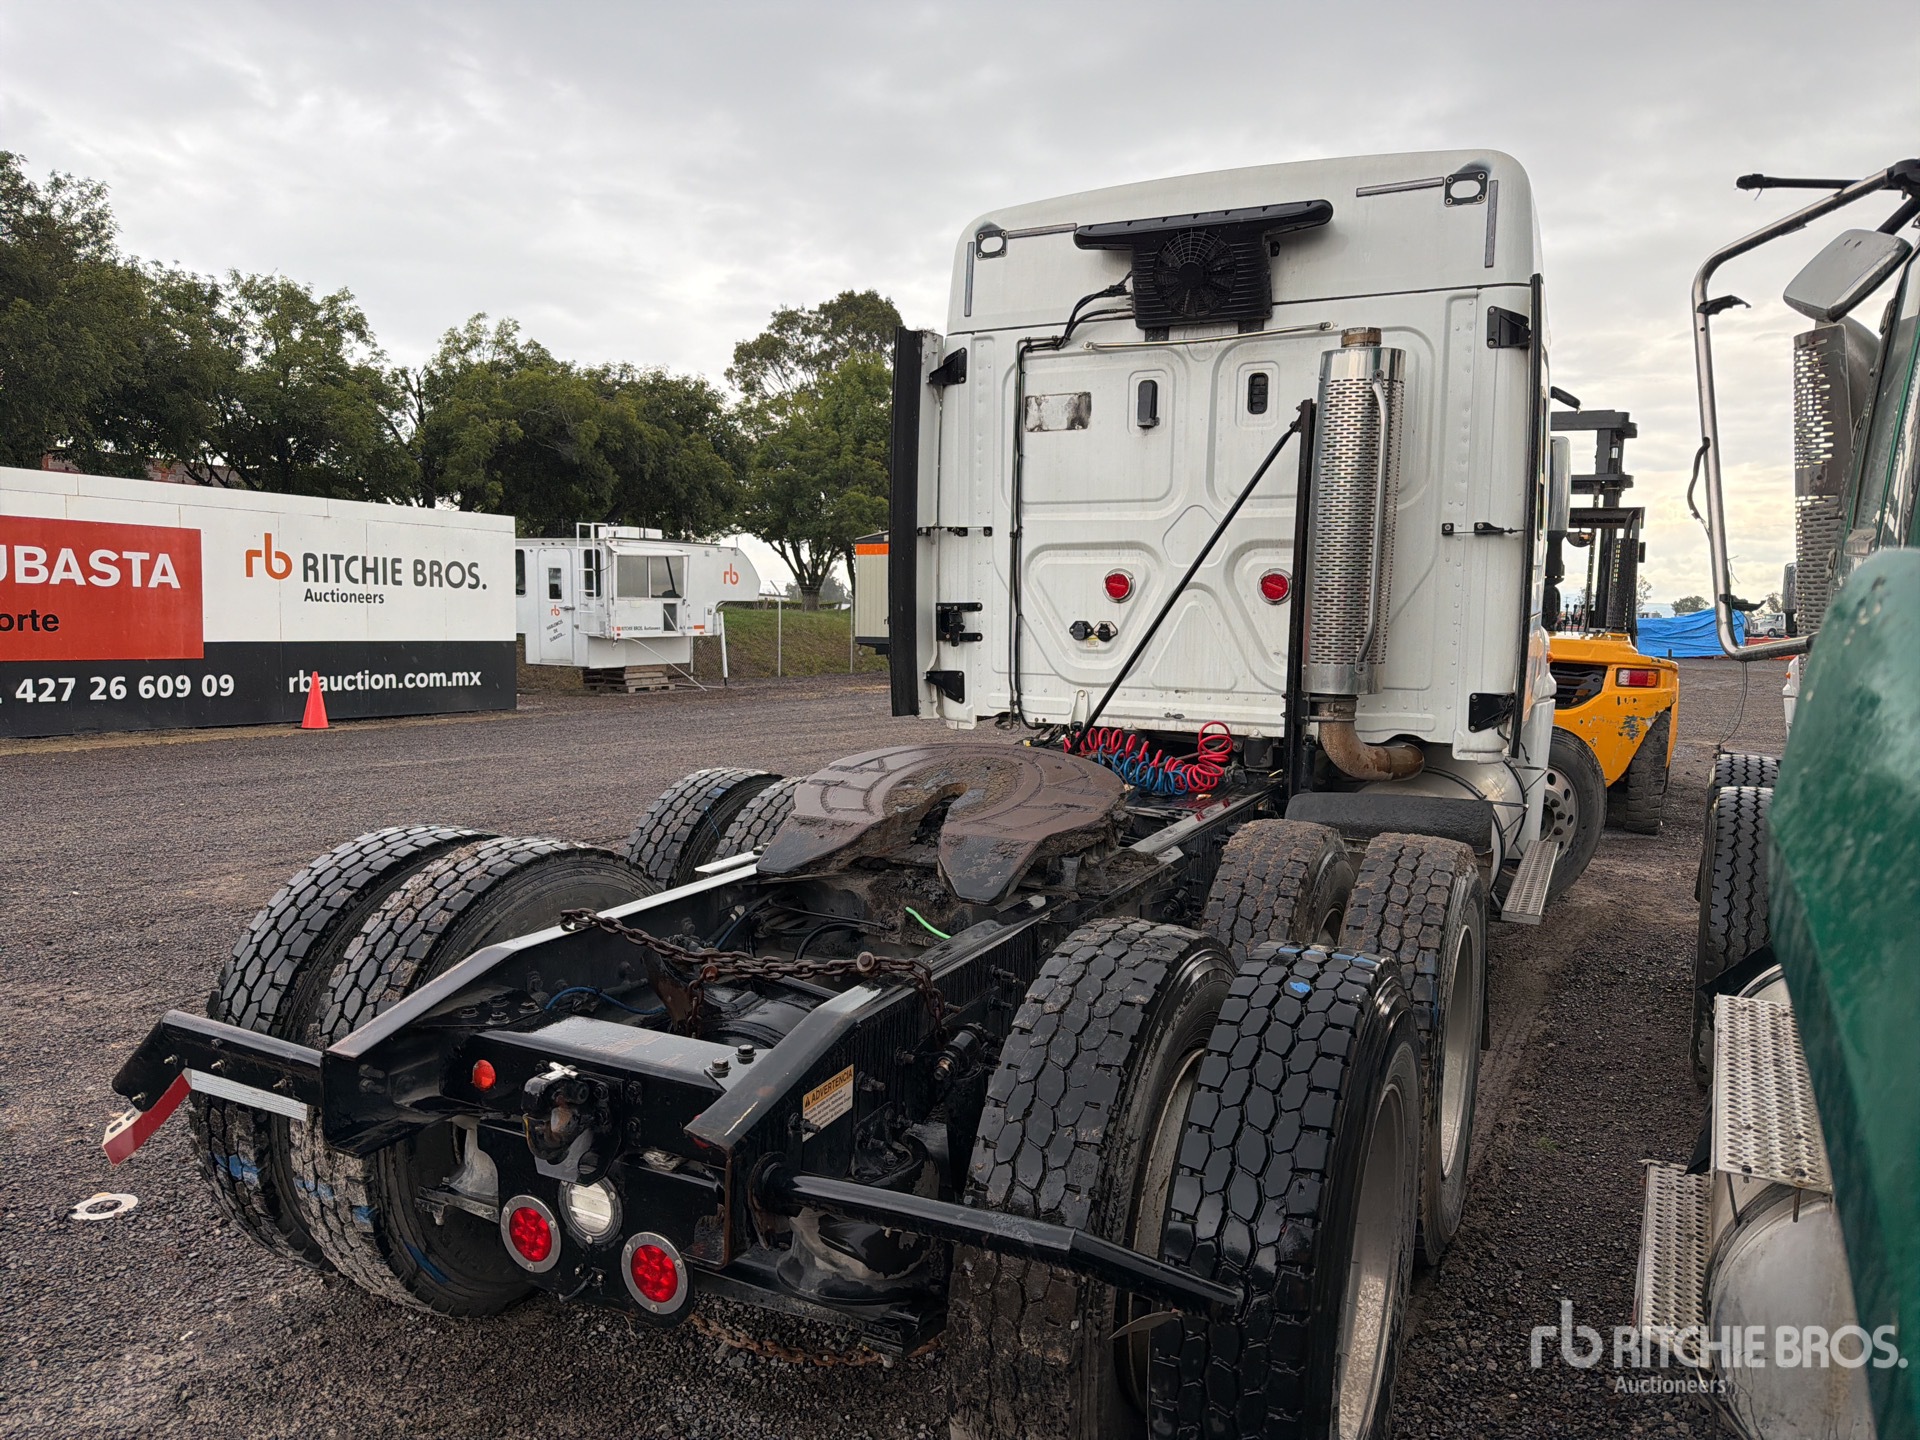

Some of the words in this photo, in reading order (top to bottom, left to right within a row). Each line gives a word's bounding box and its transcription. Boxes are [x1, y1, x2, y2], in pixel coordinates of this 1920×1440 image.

[0, 544, 181, 589] BASTA
[246, 533, 292, 580] rb
[302, 552, 403, 586] RITCHIE
[413, 558, 487, 590] BROS.
[723, 563, 739, 585] rb
[304, 588, 385, 605] Auctioneers
[15, 677, 76, 703] 427
[89, 676, 127, 700] 26
[138, 675, 192, 699] 609
[201, 674, 235, 697] 09
[288, 669, 482, 693] rbauction.com.mx
[811, 1068, 853, 1103] ADVERTENCIA
